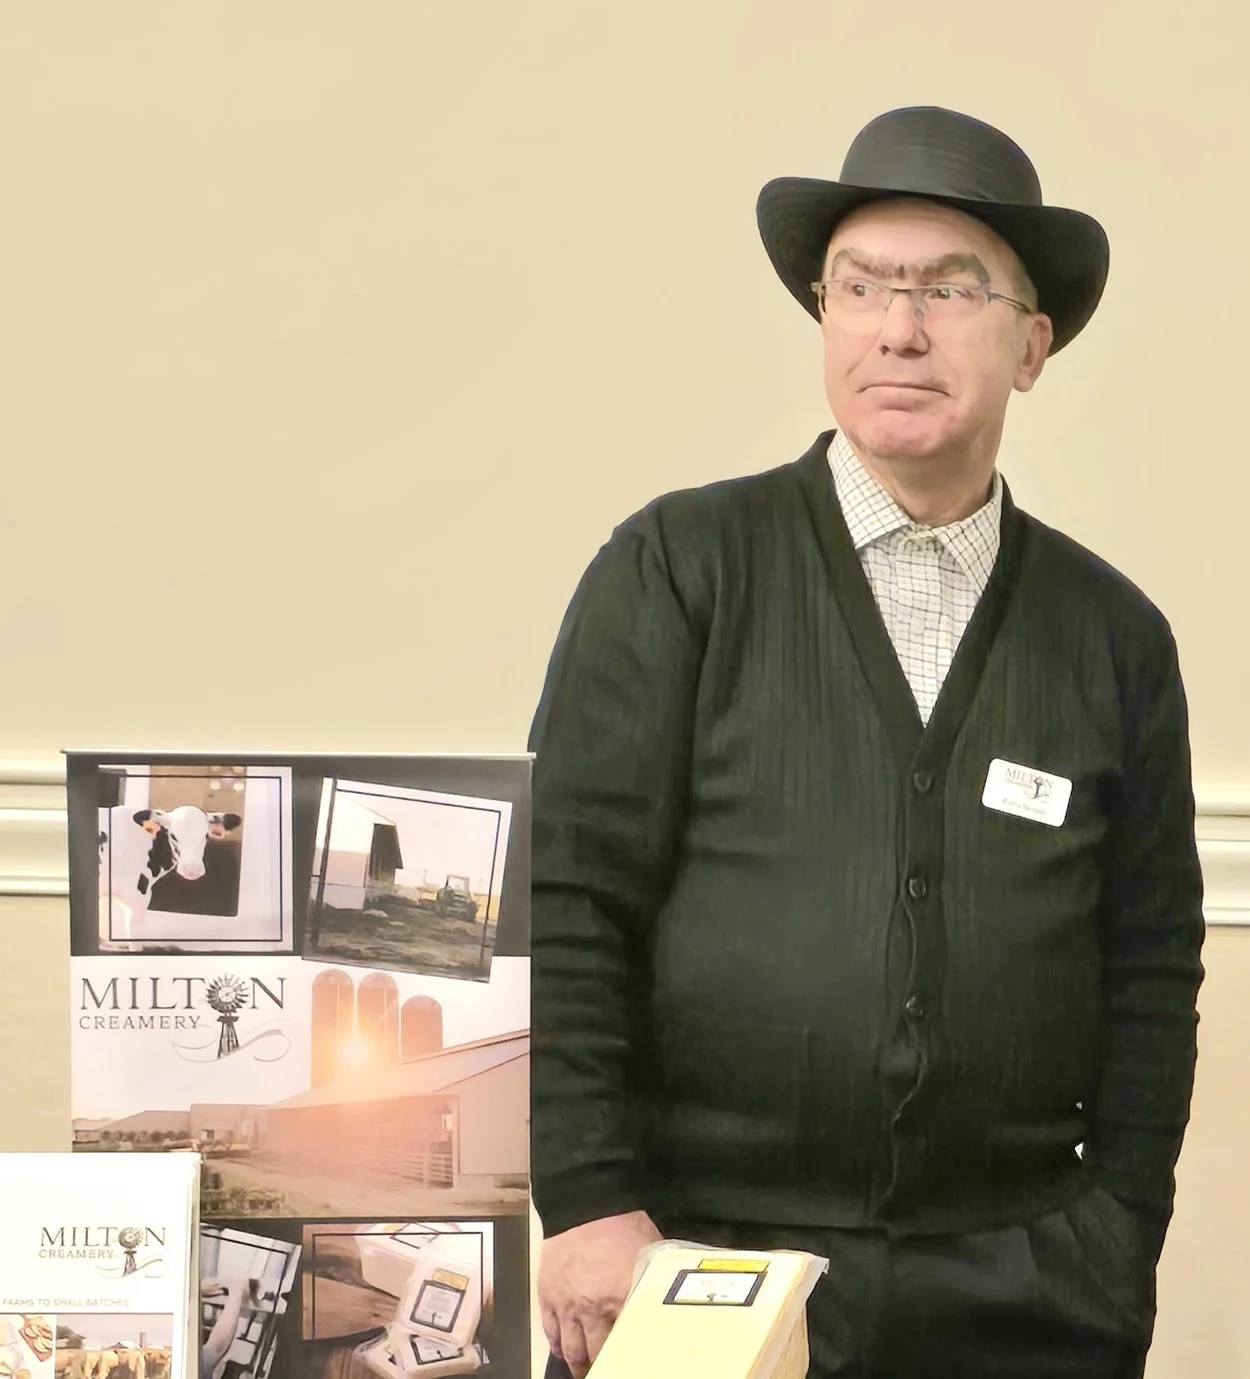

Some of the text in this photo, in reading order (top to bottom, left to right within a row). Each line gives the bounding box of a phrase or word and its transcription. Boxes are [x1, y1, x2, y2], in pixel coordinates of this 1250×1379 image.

[79, 973, 287, 1014] MILTON
[79, 1015, 201, 1030] CREAMERY
[40, 1226, 166, 1249] MILTON
[38, 1248, 115, 1259] CREAMERY
